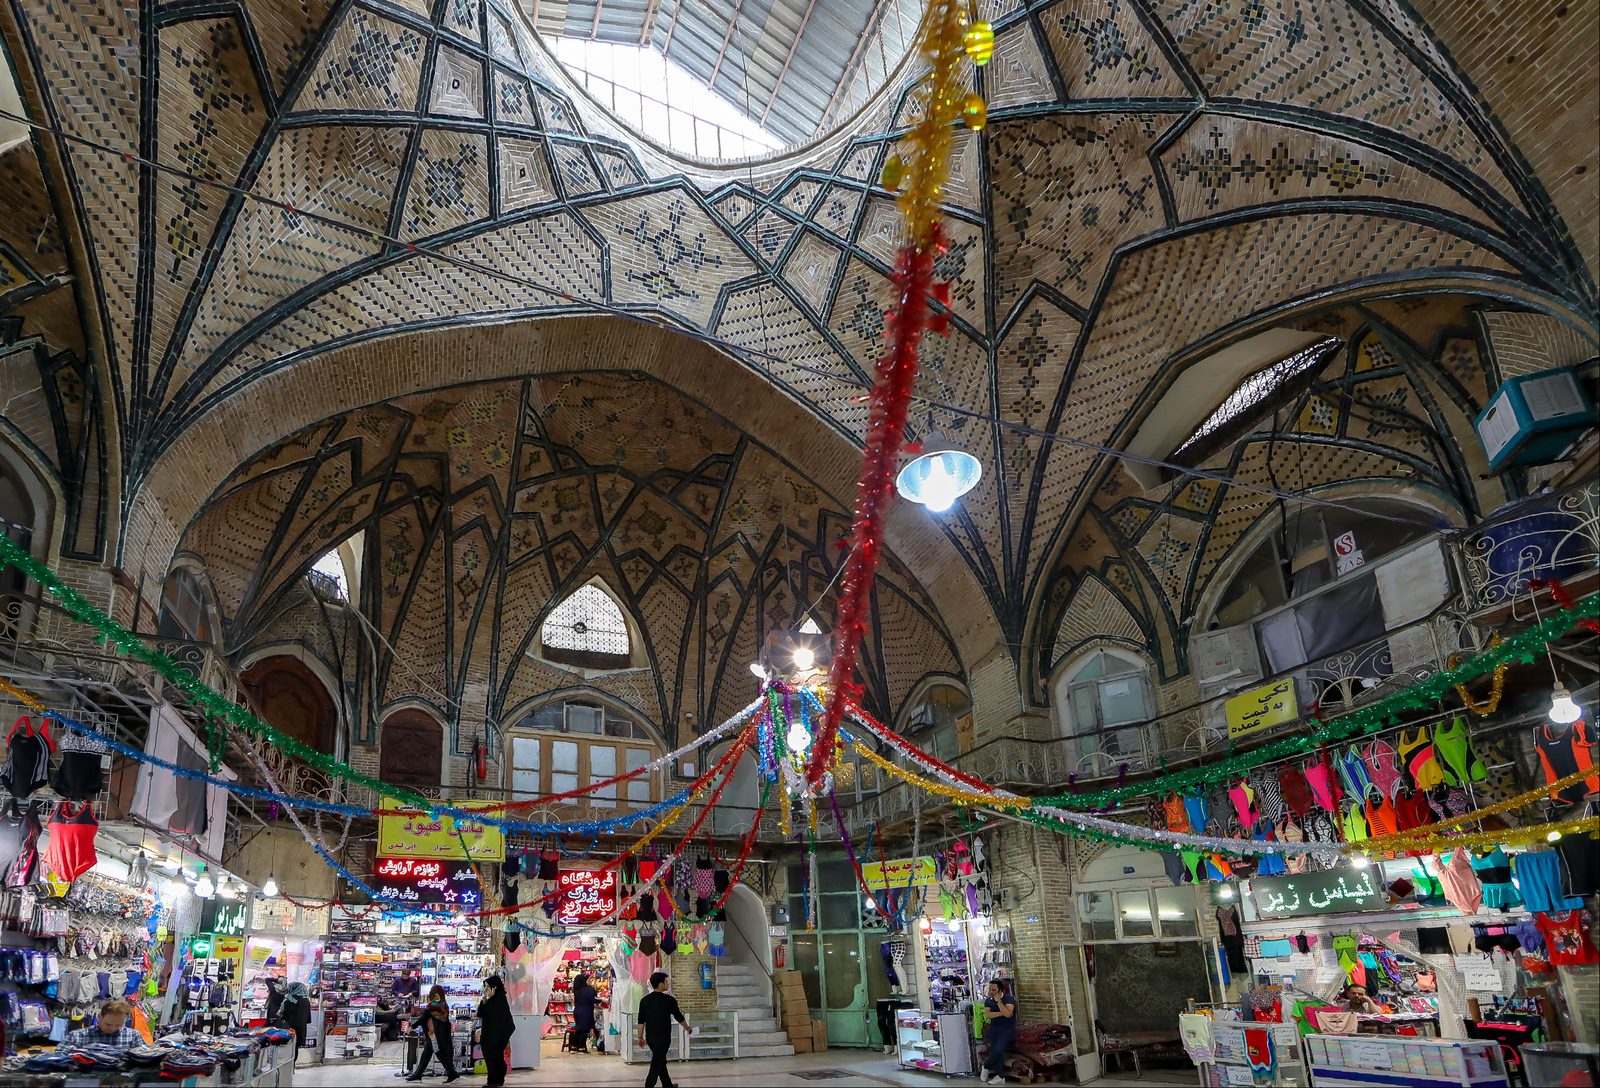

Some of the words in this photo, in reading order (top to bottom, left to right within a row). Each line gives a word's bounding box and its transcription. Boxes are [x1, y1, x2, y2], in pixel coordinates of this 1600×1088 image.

[1258, 682, 1289, 703] تکی
[1242, 703, 1269, 720] قیمت
[1273, 702, 1283, 711] به
[1231, 719, 1260, 733] عمده
[380, 860, 414, 875] آرایشی
[414, 863, 440, 876] لوازم
[561, 871, 613, 889] فروشگاه
[399, 886, 419, 900] ریش
[567, 885, 599, 903] بزرگ
[1262, 883, 1299, 912] زیر
[1308, 872, 1374, 908] لباس
[561, 900, 581, 917] زیر
[582, 899, 613, 916] لباس
[215, 905, 230, 934] زیر
[229, 904, 247, 935] لباس
